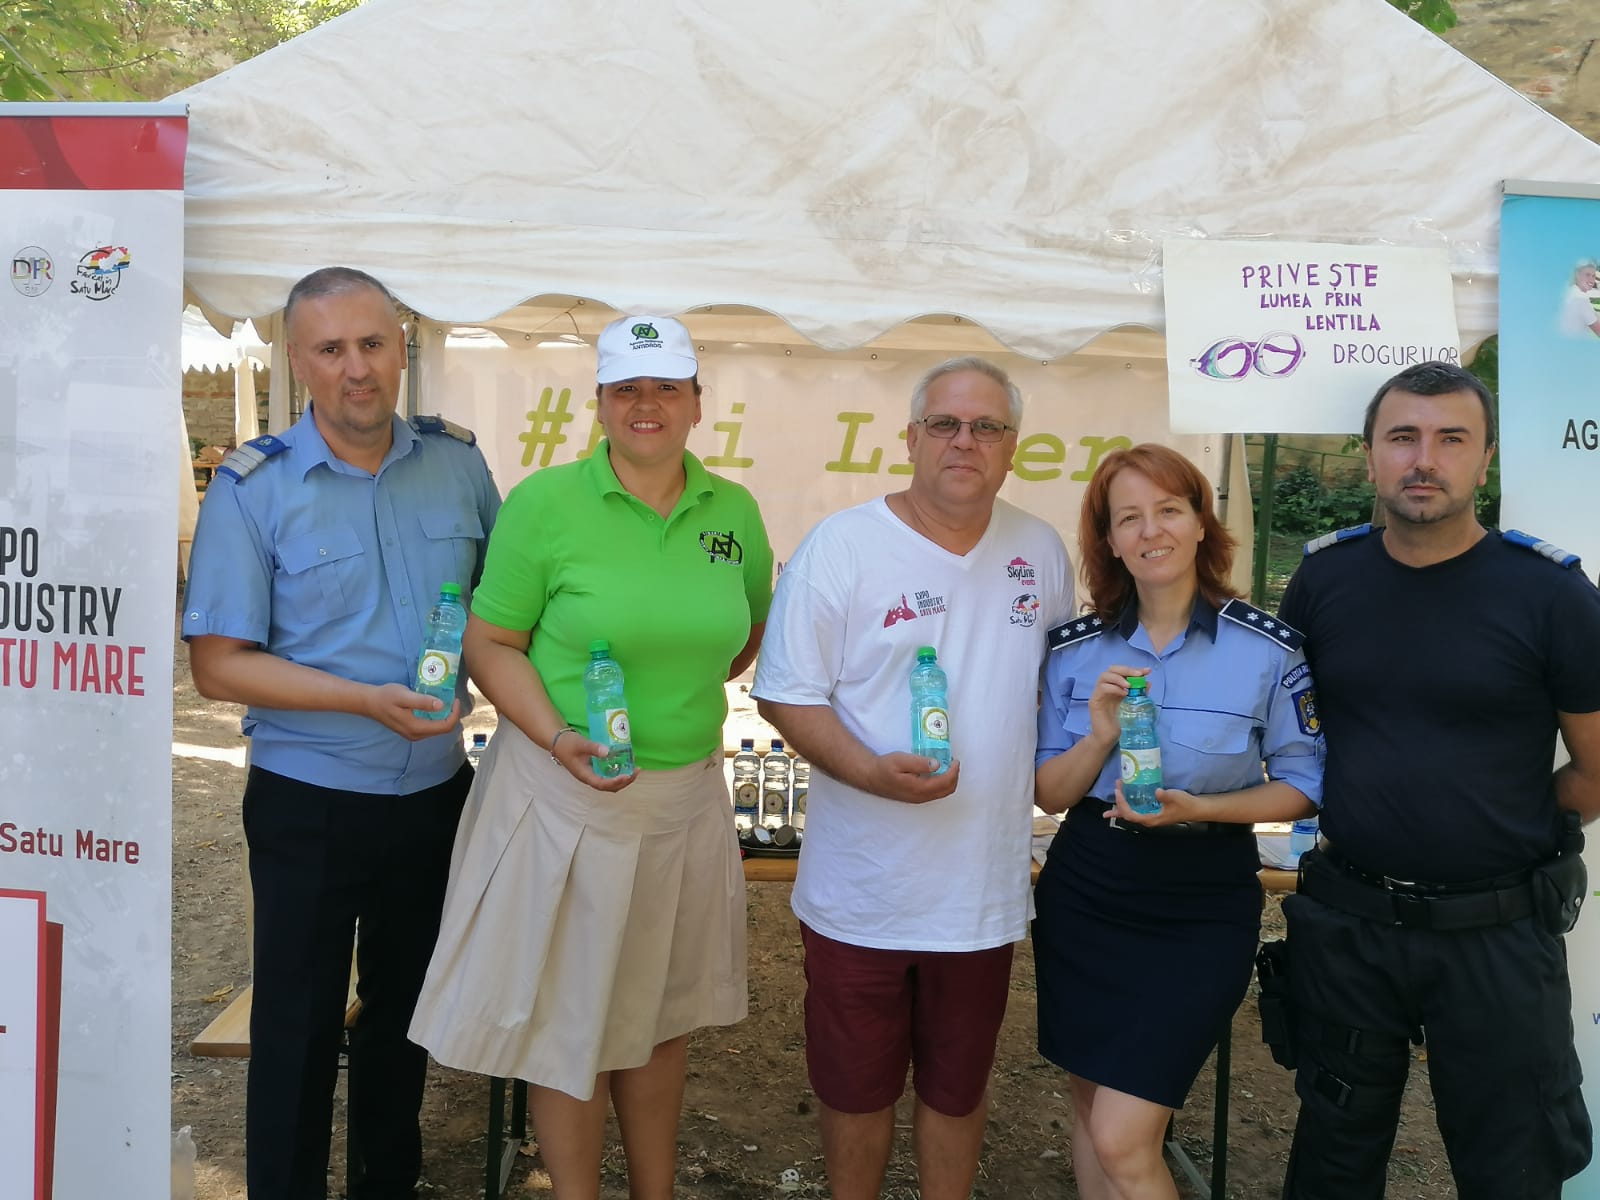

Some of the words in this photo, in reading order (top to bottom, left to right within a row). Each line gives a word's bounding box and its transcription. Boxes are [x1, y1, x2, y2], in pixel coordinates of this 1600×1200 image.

[1260, 292, 1312, 308] LUMEA
[1325, 292, 1362, 307] PRIN
[1305, 314, 1381, 331] LENTILA
[53, 641, 146, 697] MARE
[0, 822, 63, 858] Satu
[76, 829, 139, 865] Mare
